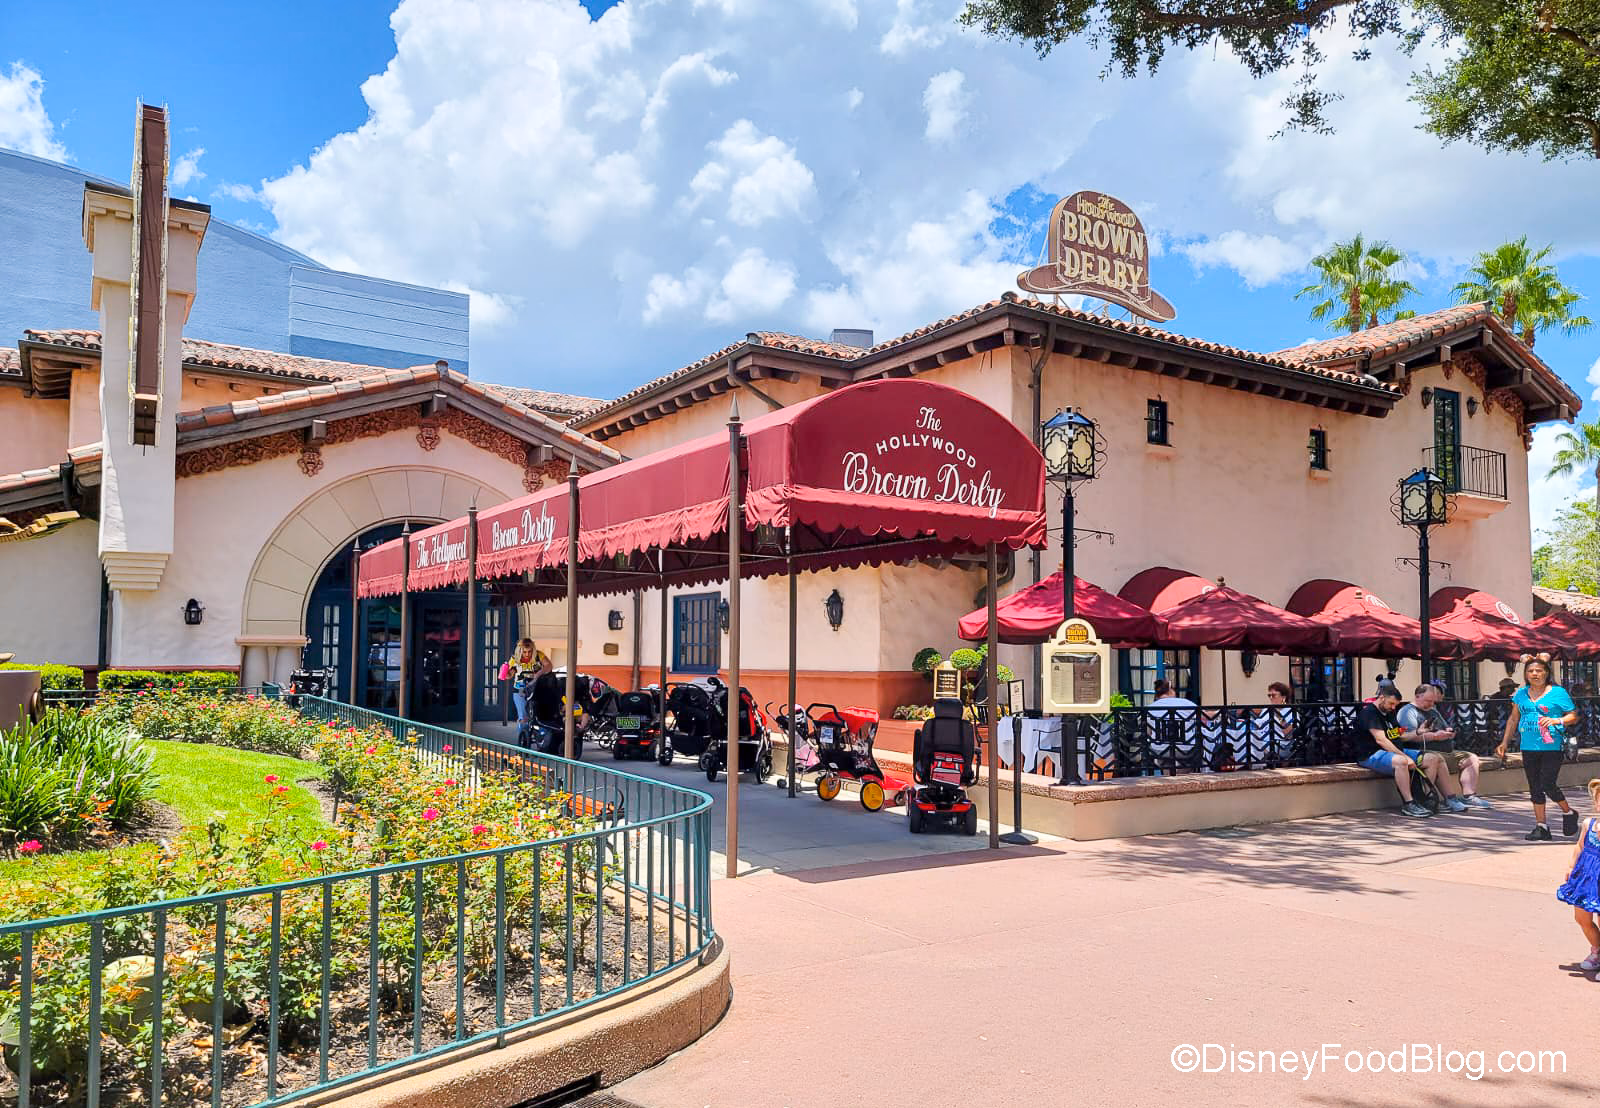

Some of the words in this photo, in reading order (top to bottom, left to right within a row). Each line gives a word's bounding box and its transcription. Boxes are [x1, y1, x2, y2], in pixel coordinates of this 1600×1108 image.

[1098, 193, 1115, 211] The
[1062, 210, 1145, 261] BROWN
[1063, 246, 1144, 295] DERBY
[916, 406, 942, 432] The
[875, 435, 977, 469] HOLLYWOOD
[842, 451, 930, 498] Brown
[934, 463, 1006, 519] Derby
[492, 520, 518, 551] Brown
[520, 499, 557, 551] Derby
[416, 539, 429, 569] The
[430, 527, 467, 570] Hollywood
